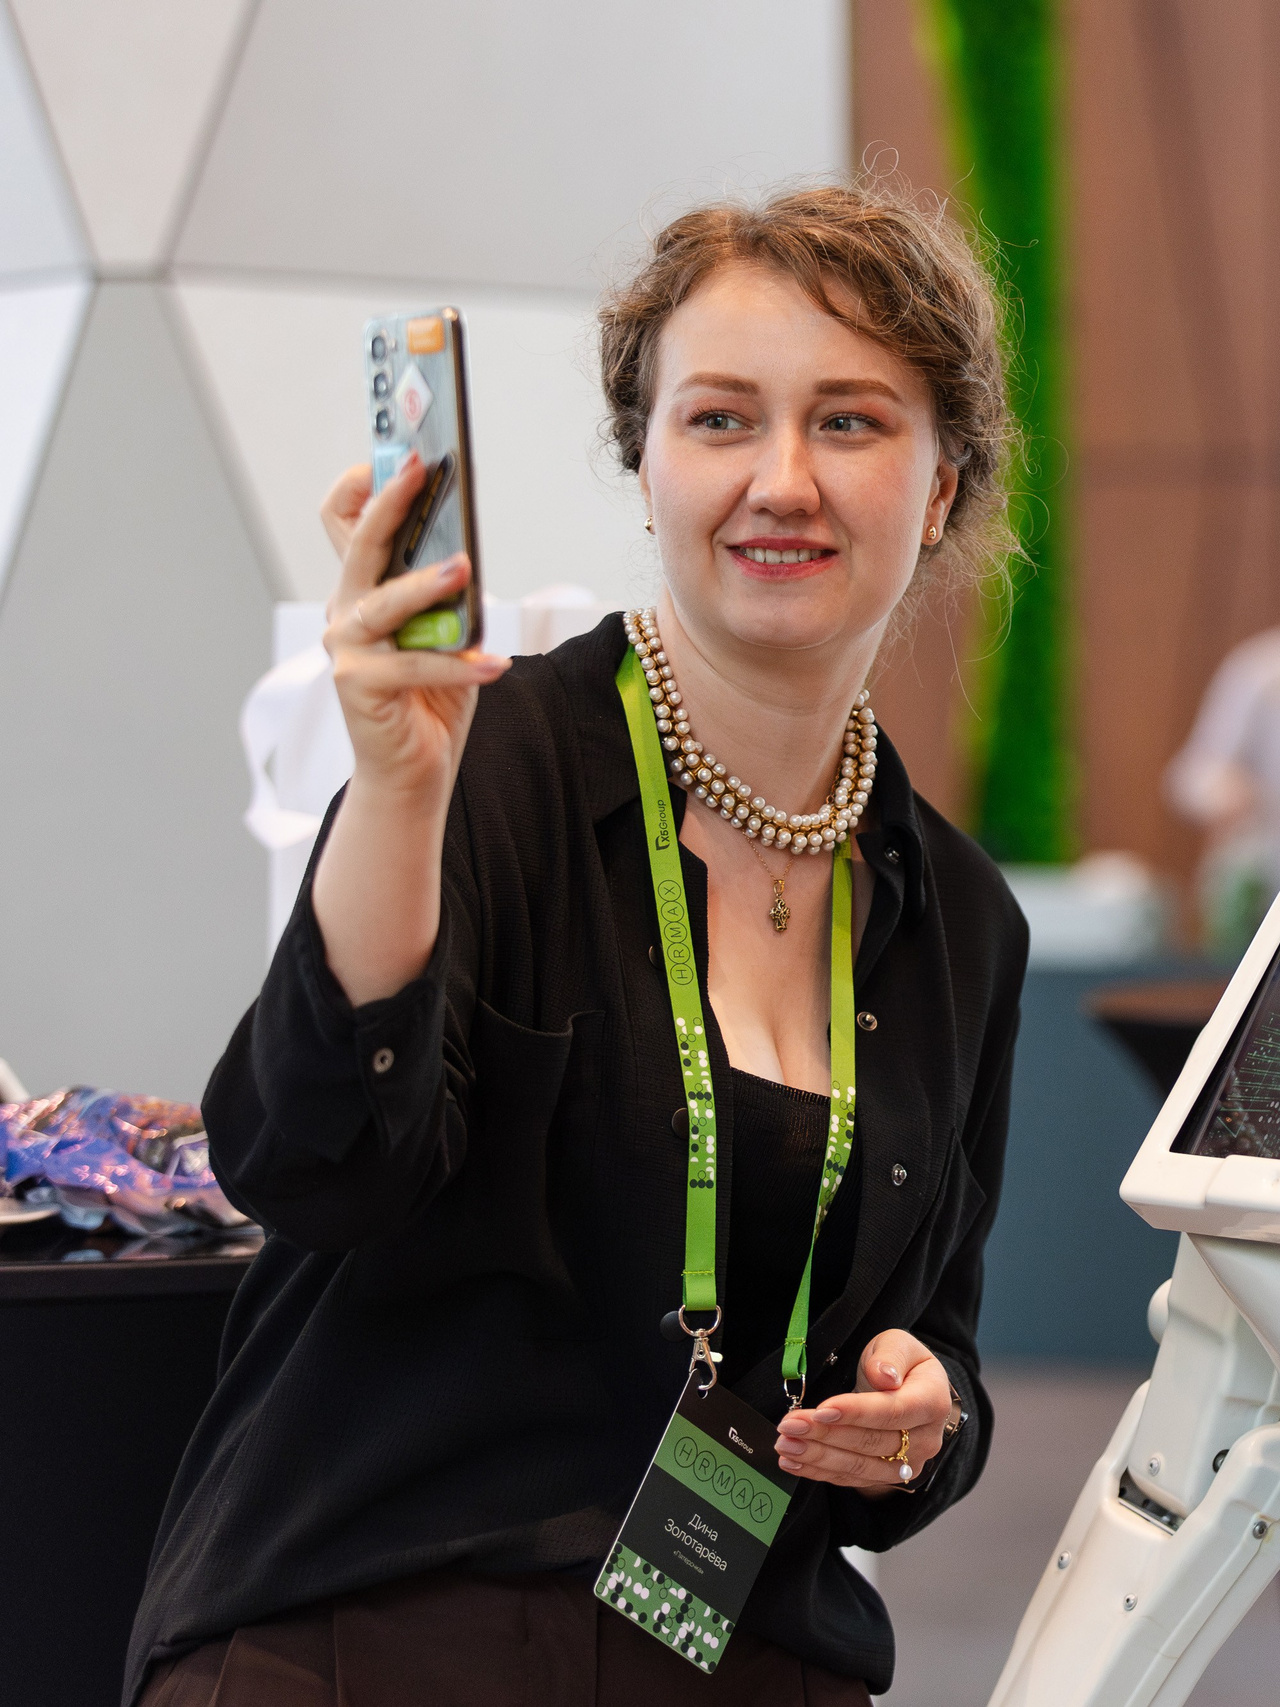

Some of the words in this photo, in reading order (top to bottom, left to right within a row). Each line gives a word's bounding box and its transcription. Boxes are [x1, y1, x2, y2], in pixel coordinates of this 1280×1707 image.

[661, 883, 691, 982] HRMAX
[677, 1440, 770, 1520] HRMAX
[664, 1518, 728, 1571] Золотарёва
[687, 1513, 719, 1542] Дина
